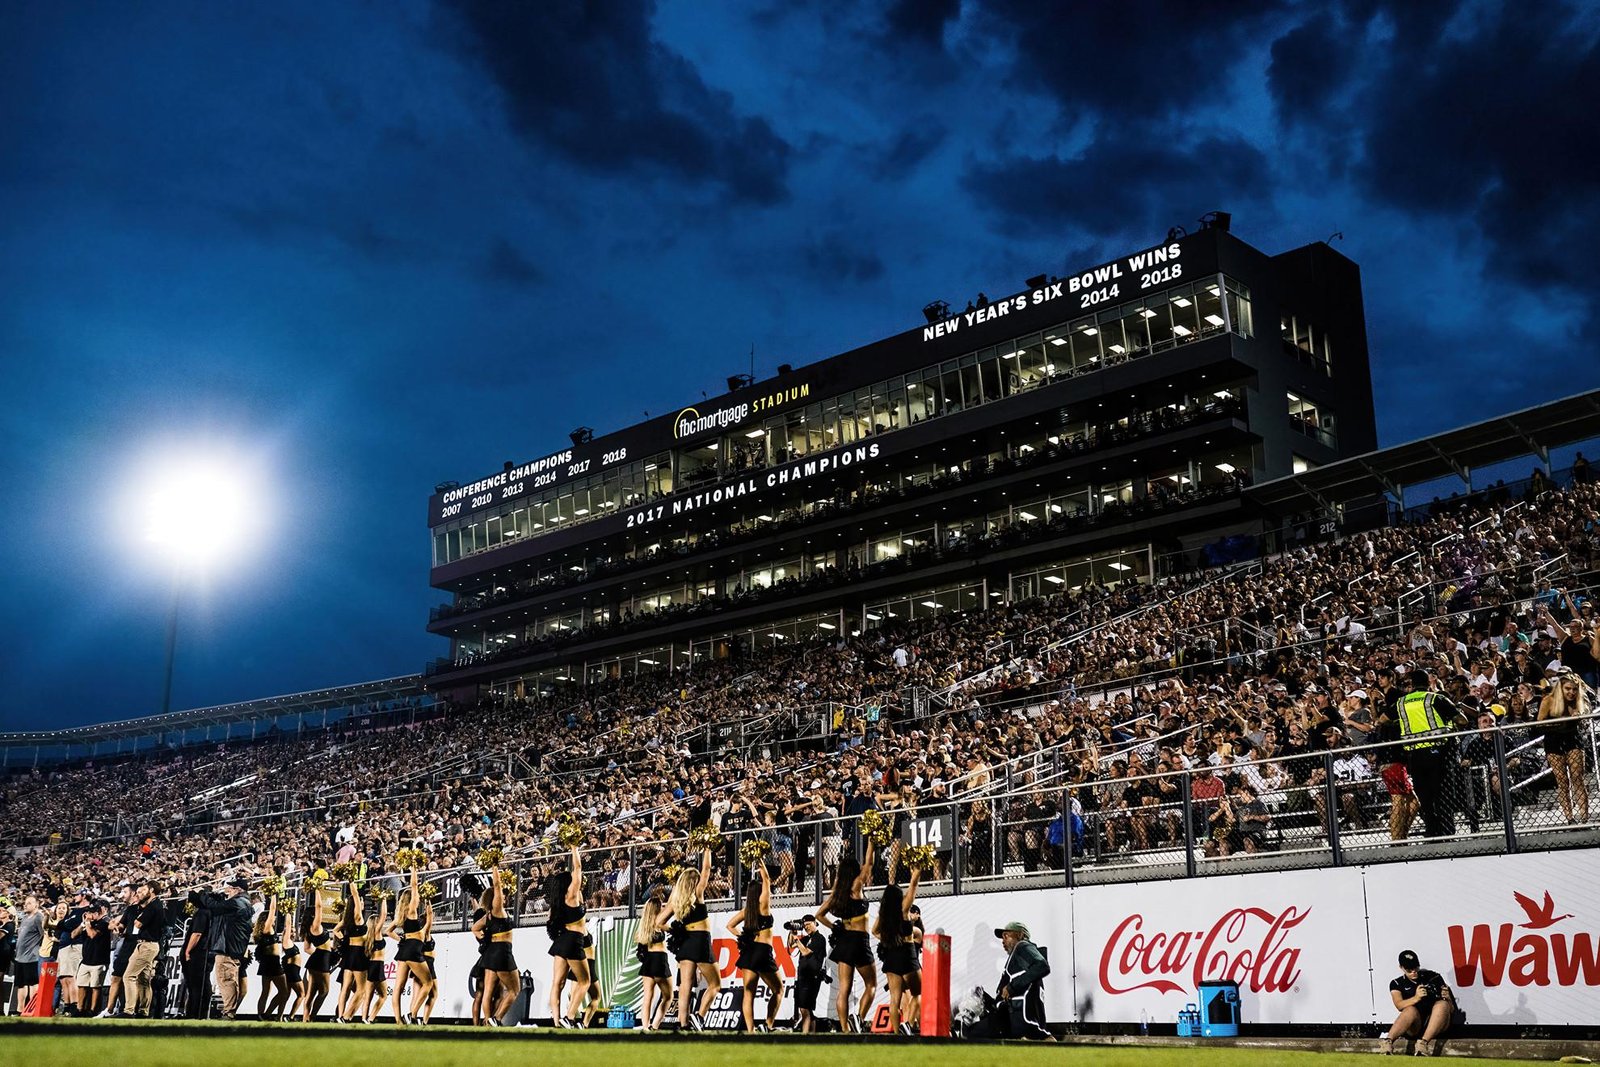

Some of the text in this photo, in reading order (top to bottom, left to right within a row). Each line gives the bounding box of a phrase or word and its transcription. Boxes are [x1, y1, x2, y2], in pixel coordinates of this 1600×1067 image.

[923, 243, 1181, 342] NEW YEAR'S SIX BOWL WINS
[1080, 263, 1183, 309] 2014 2018
[752, 383, 811, 413] STADIUM
[442, 450, 573, 504] CONFERENCE CHAMPIONS
[442, 447, 627, 518] 2007 2010 2013 2014 2017 2018
[627, 443, 880, 528] 2017 NATIONAL CHAMPIONS
[1320, 522, 1336, 534] 212
[909, 819, 942, 847] 114
[446, 877, 461, 899] 113
[1098, 905, 1312, 996] Coca-Cola
[709, 991, 734, 1010] GO
[875, 1006, 889, 1028] G
